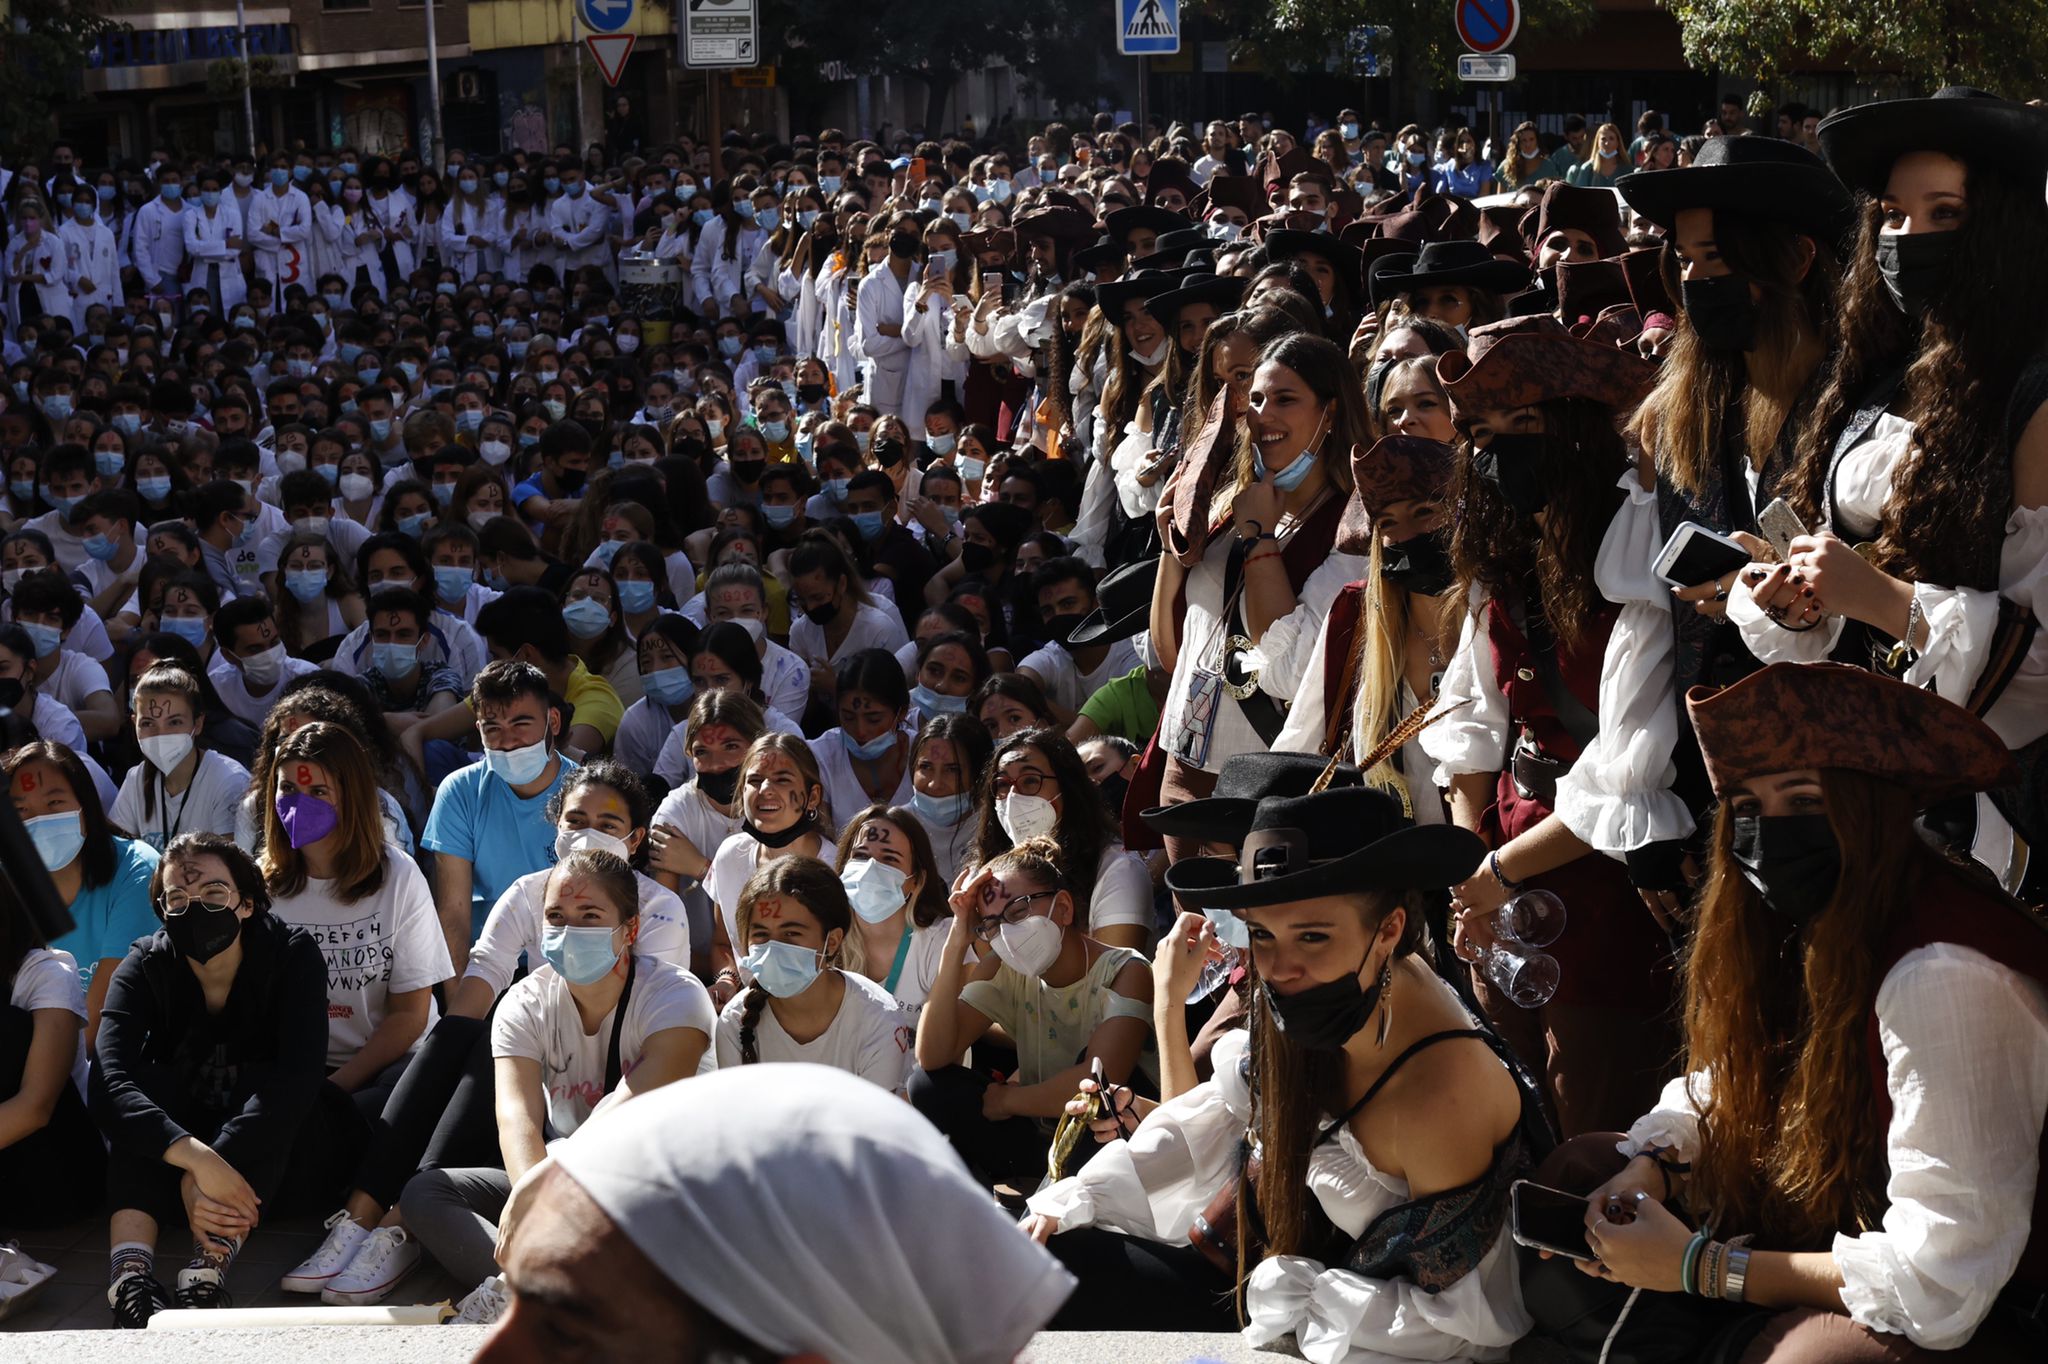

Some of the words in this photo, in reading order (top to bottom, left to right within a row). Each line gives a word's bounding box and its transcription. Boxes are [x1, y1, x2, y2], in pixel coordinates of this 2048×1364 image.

[281, 243, 301, 284] 3
[296, 765, 312, 786] B
[866, 825, 891, 843] B2
[758, 900, 782, 919] B2
